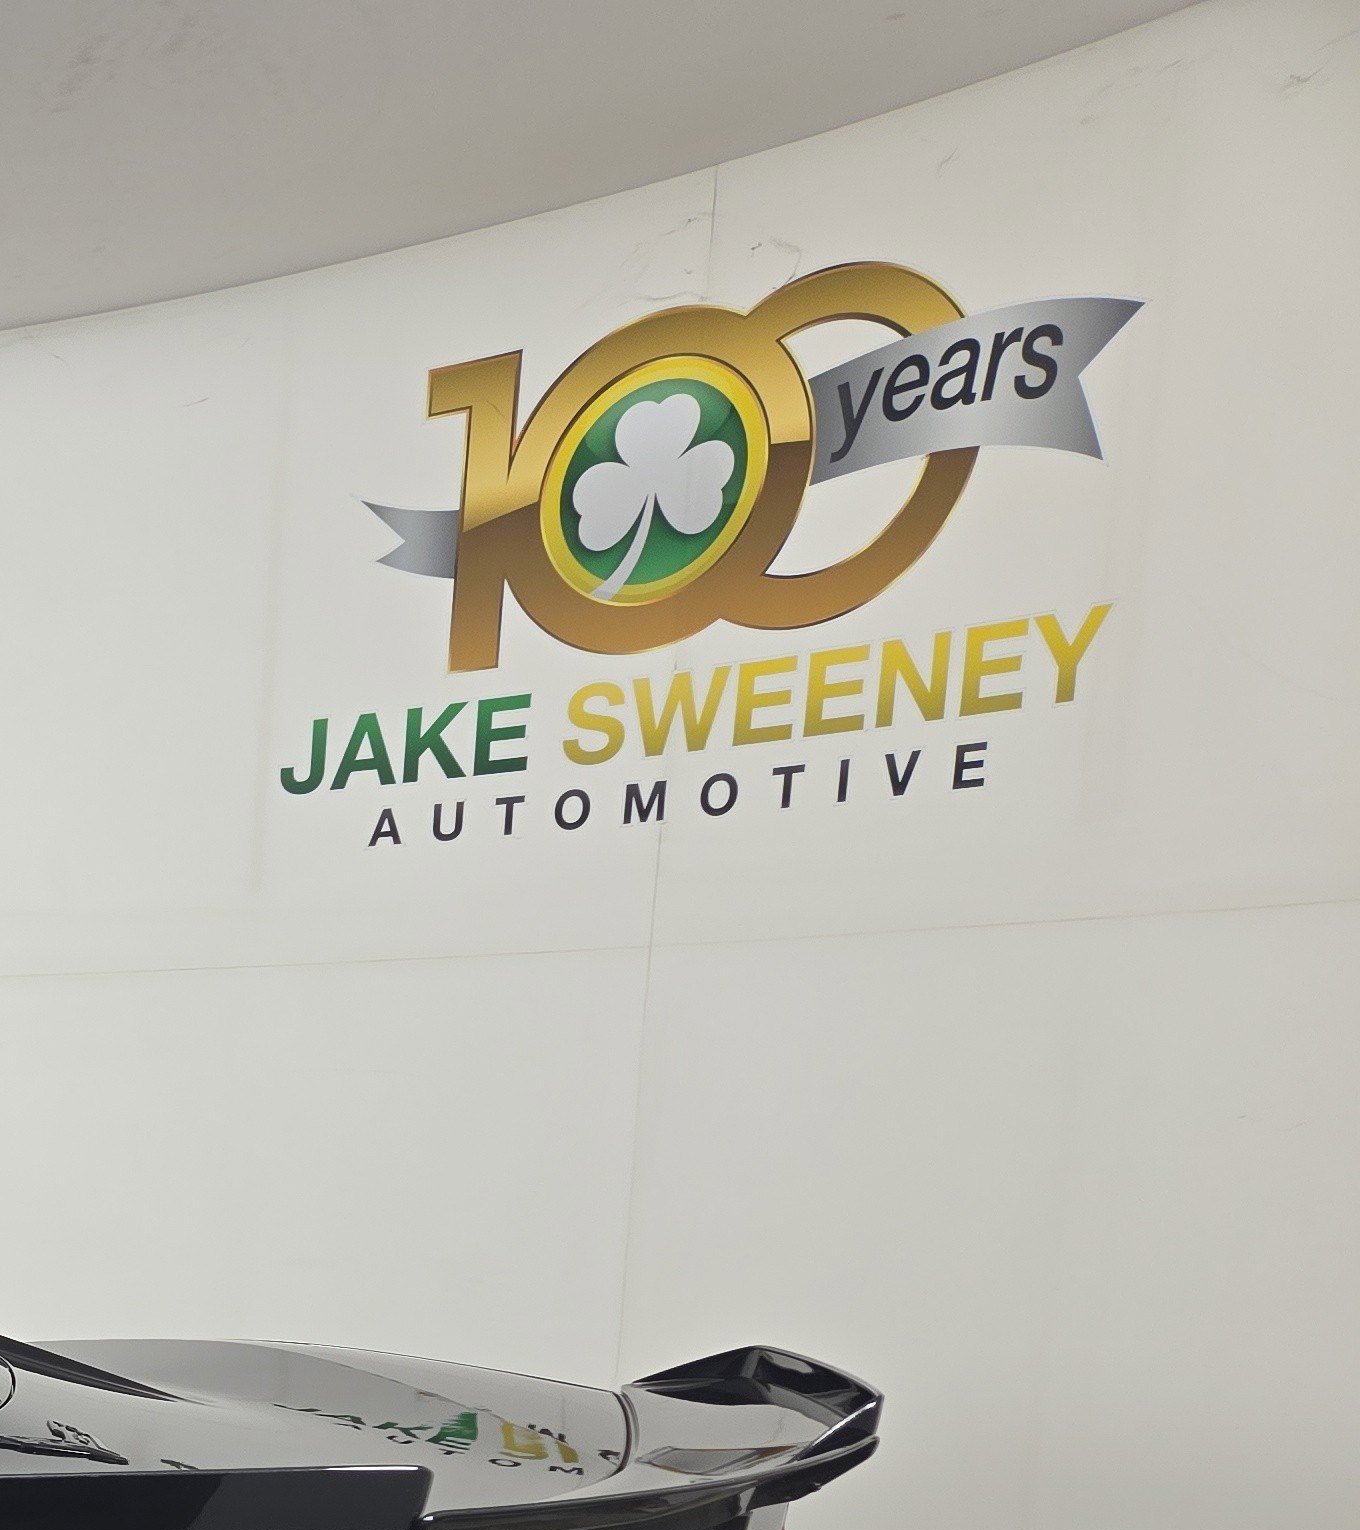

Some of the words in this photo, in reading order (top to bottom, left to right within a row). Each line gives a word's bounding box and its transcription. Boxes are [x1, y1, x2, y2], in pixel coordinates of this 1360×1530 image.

[427, 261, 981, 675] 100
[830, 319, 1063, 463] years
[280, 693, 533, 796] JAKE
[562, 603, 1113, 766] SWEENEY
[369, 741, 989, 848] AUTOMOTIVE
